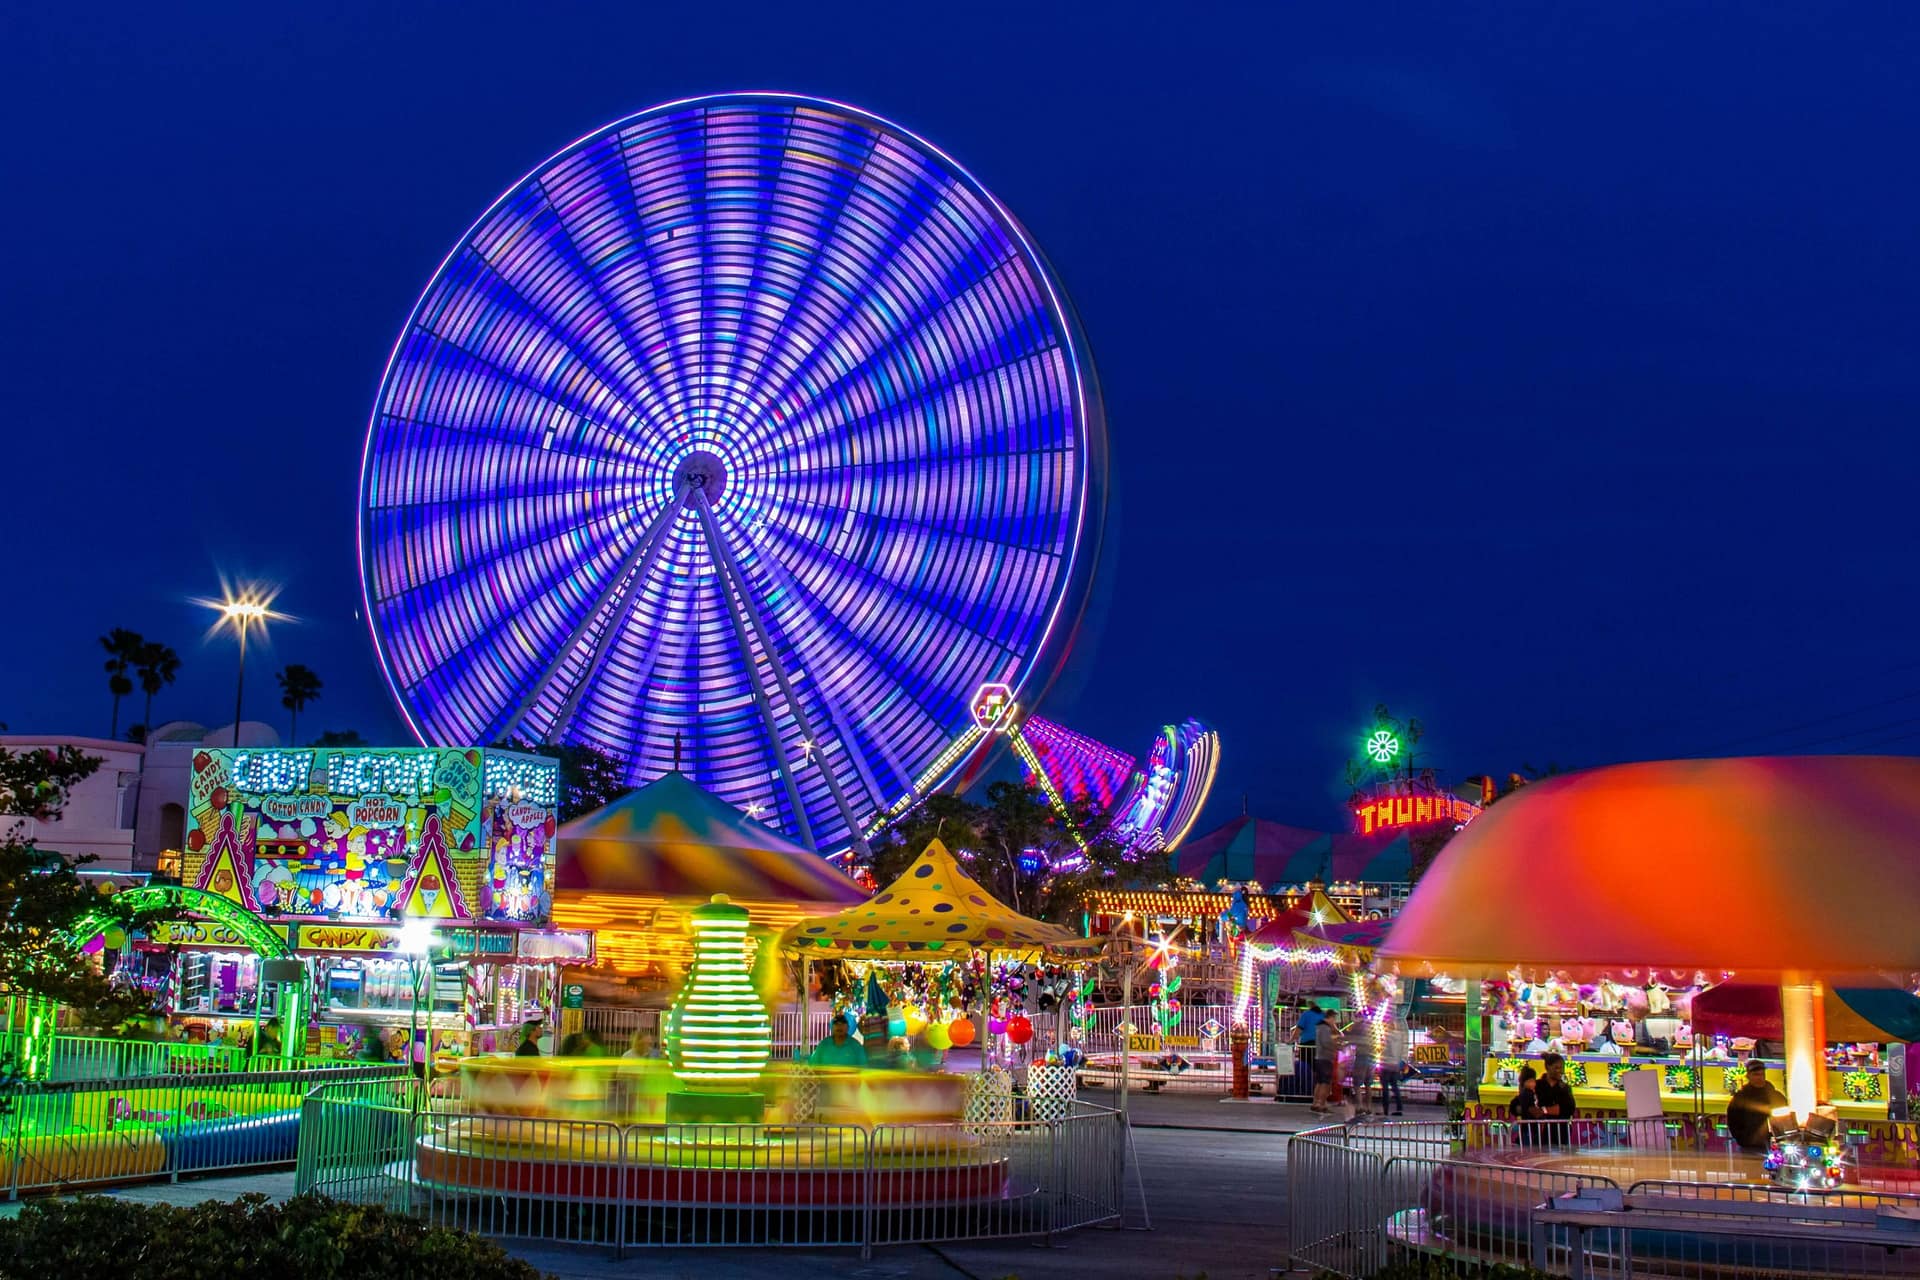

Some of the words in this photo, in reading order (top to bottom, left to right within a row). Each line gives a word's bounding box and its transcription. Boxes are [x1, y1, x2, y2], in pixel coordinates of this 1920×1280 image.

[194, 759, 222, 789] CANDY
[450, 760, 471, 783] SNO
[200, 769, 229, 799] APPLES
[439, 768, 469, 800] CONES
[267, 800, 297, 817] COTTON
[300, 800, 327, 816] CANDY
[366, 798, 385, 807] HOT
[355, 807, 399, 822] POPCORN
[511, 806, 532, 817] CANDY
[521, 810, 544, 823] APPLES
[169, 924, 207, 942] SNO
[306, 928, 367, 949] CANDY
[451, 933, 475, 953] OLD
[1129, 1035, 1156, 1050] EXIT
[1416, 1045, 1448, 1061] ENTER
